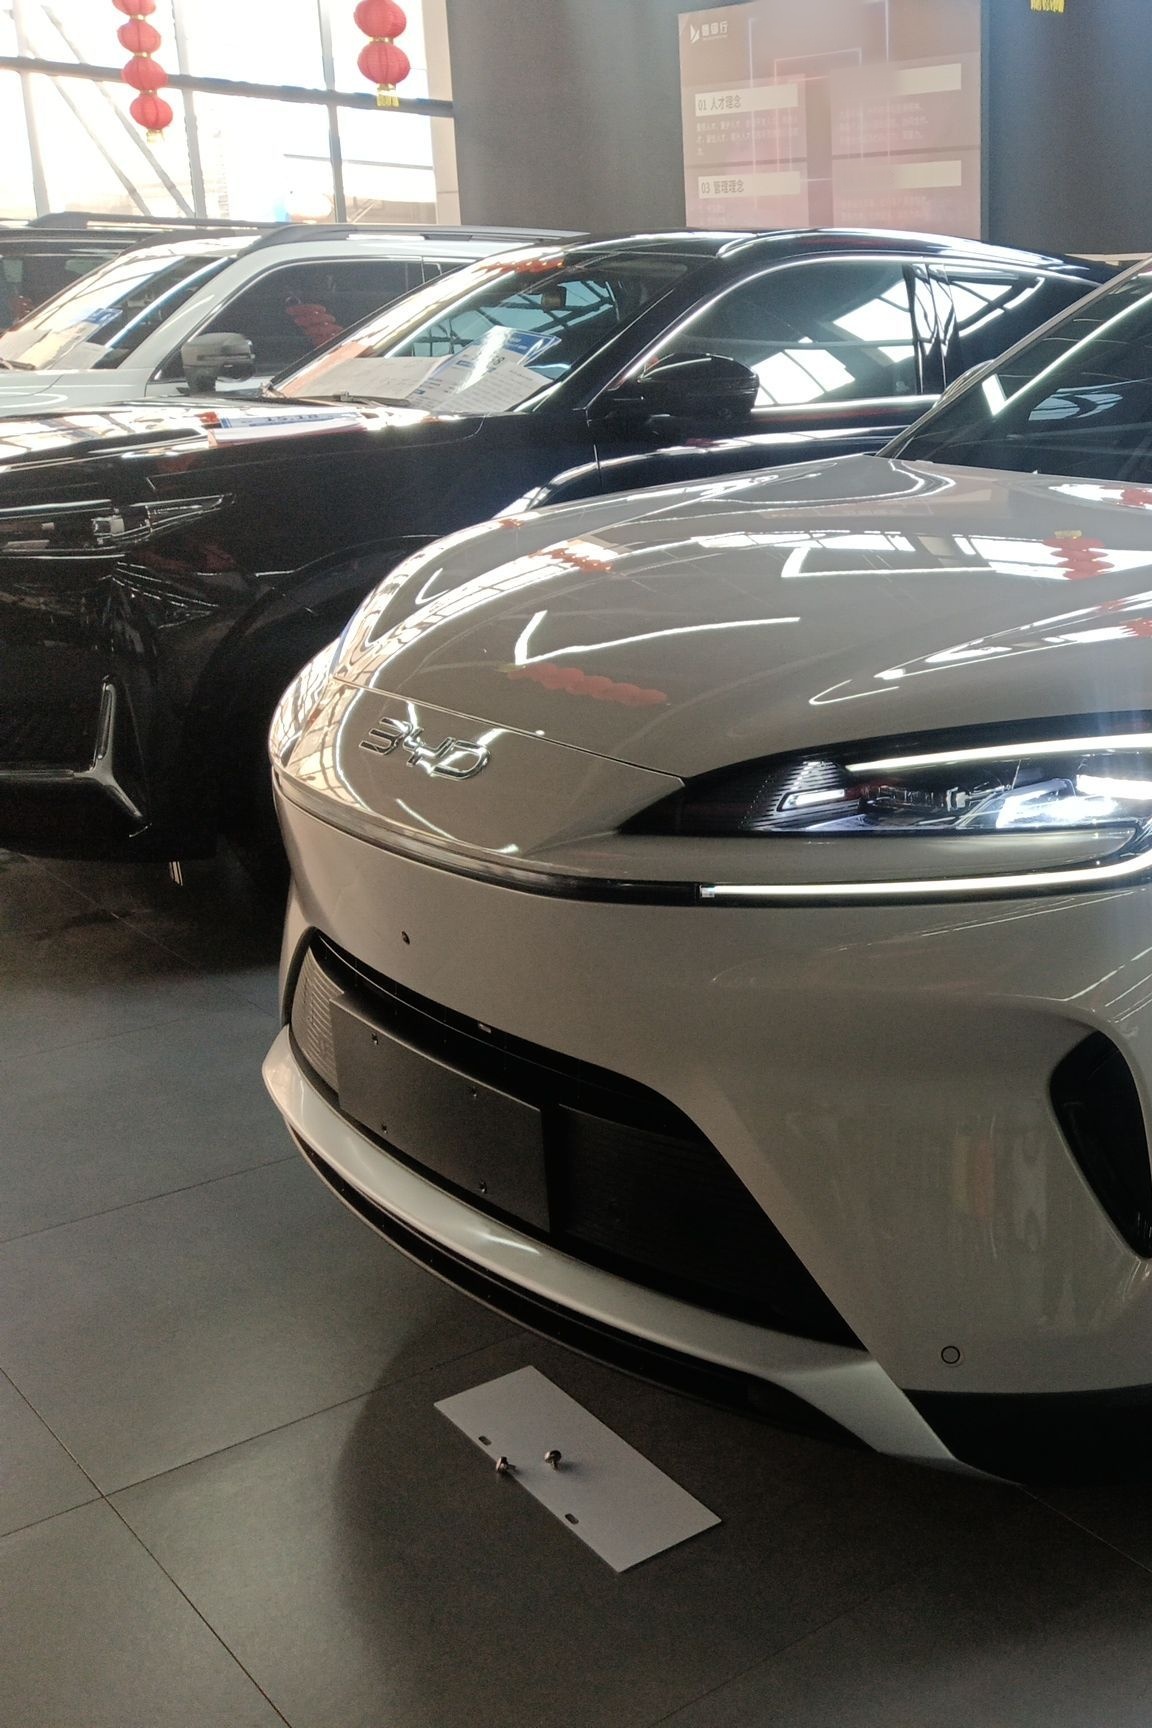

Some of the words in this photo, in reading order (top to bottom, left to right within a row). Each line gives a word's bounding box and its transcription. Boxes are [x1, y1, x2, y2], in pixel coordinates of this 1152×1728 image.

[710, 94, 742, 111] 人才理念
[359, 716, 491, 782] BYD
